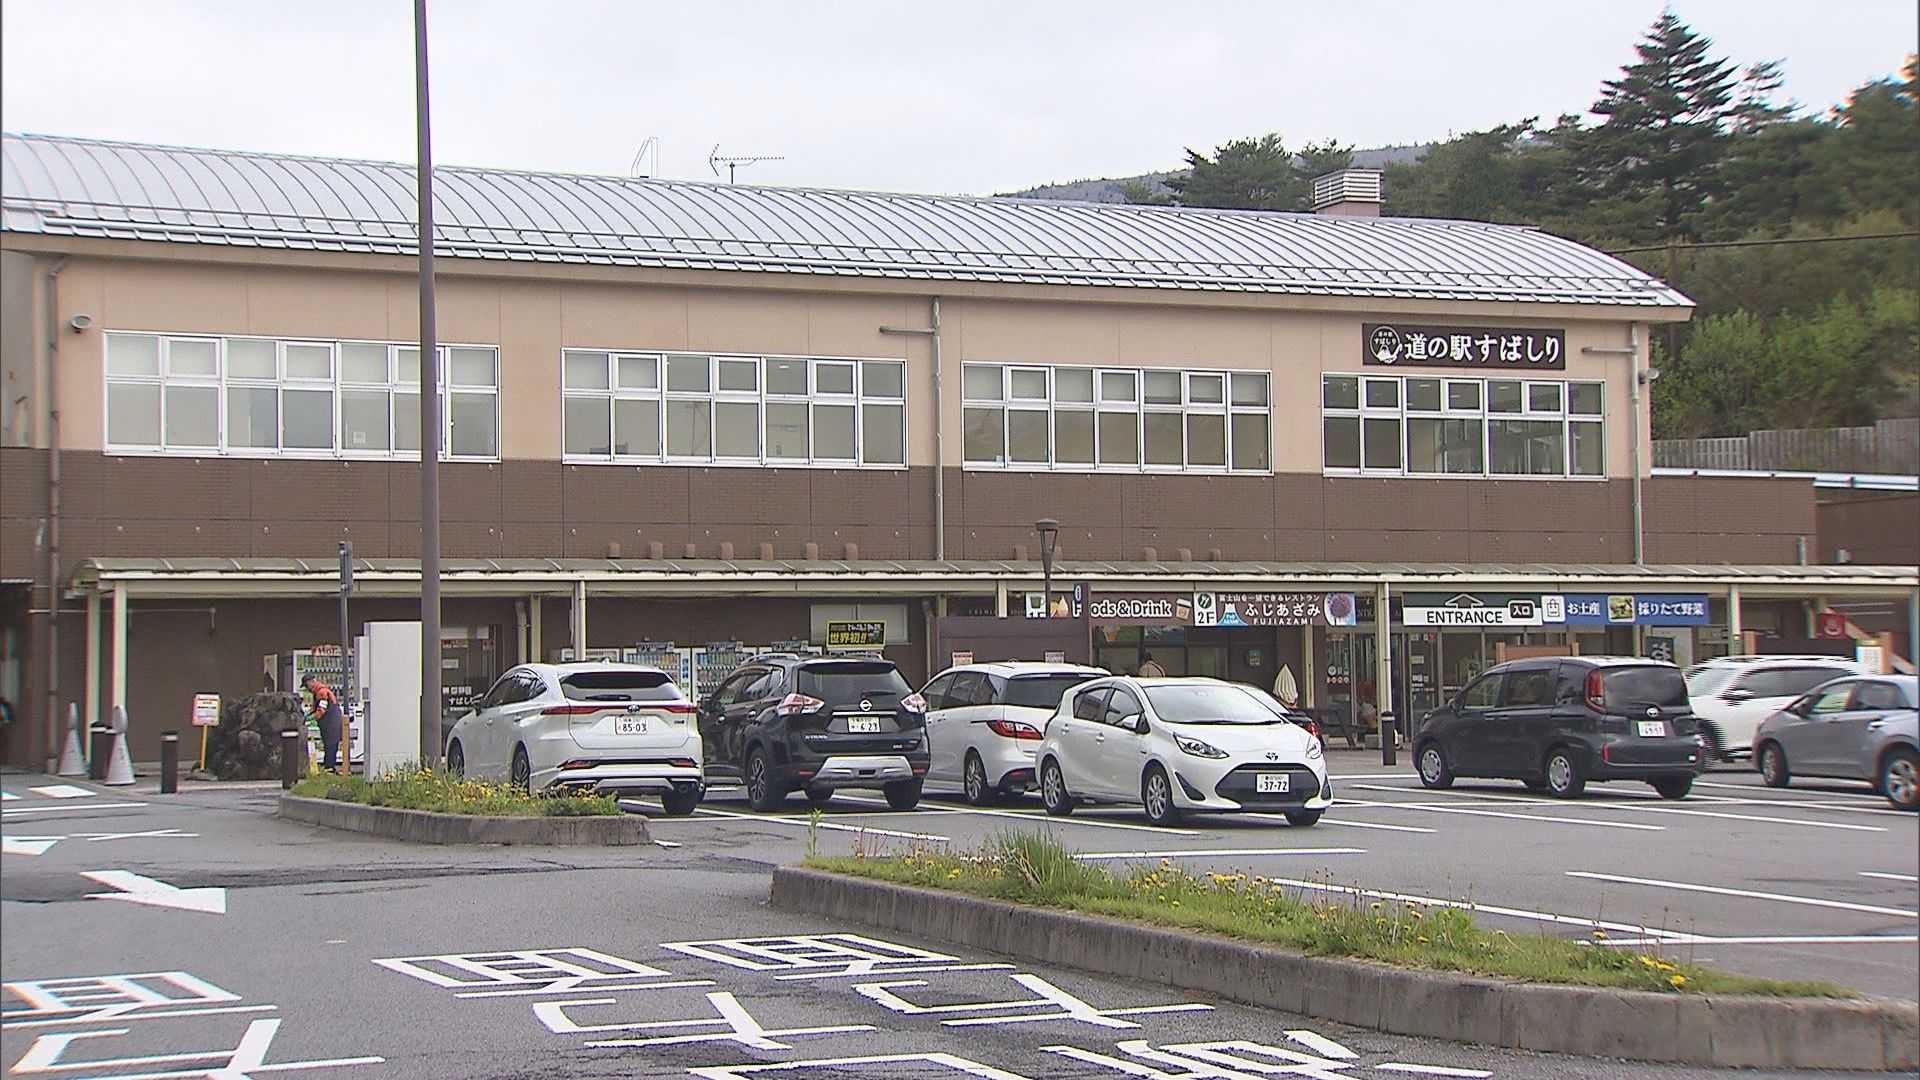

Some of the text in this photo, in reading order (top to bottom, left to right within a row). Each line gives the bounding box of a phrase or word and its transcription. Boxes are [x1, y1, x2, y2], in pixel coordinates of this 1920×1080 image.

[1404, 333, 1560, 363] 道の駅すばしり
[1074, 601, 1170, 616] Fods & Drink
[1245, 602, 1321, 617] ふじあざみ
[1512, 605, 1531, 616] 入口
[1567, 602, 1601, 616] お土産
[1637, 602, 1705, 616] 採りたて野菜
[1197, 611, 1215, 624] 2F
[1253, 617, 1313, 625] FUJIAZAMI
[1426, 611, 1503, 624] ENTRANCE
[1264, 781, 1288, 791] 37-72
